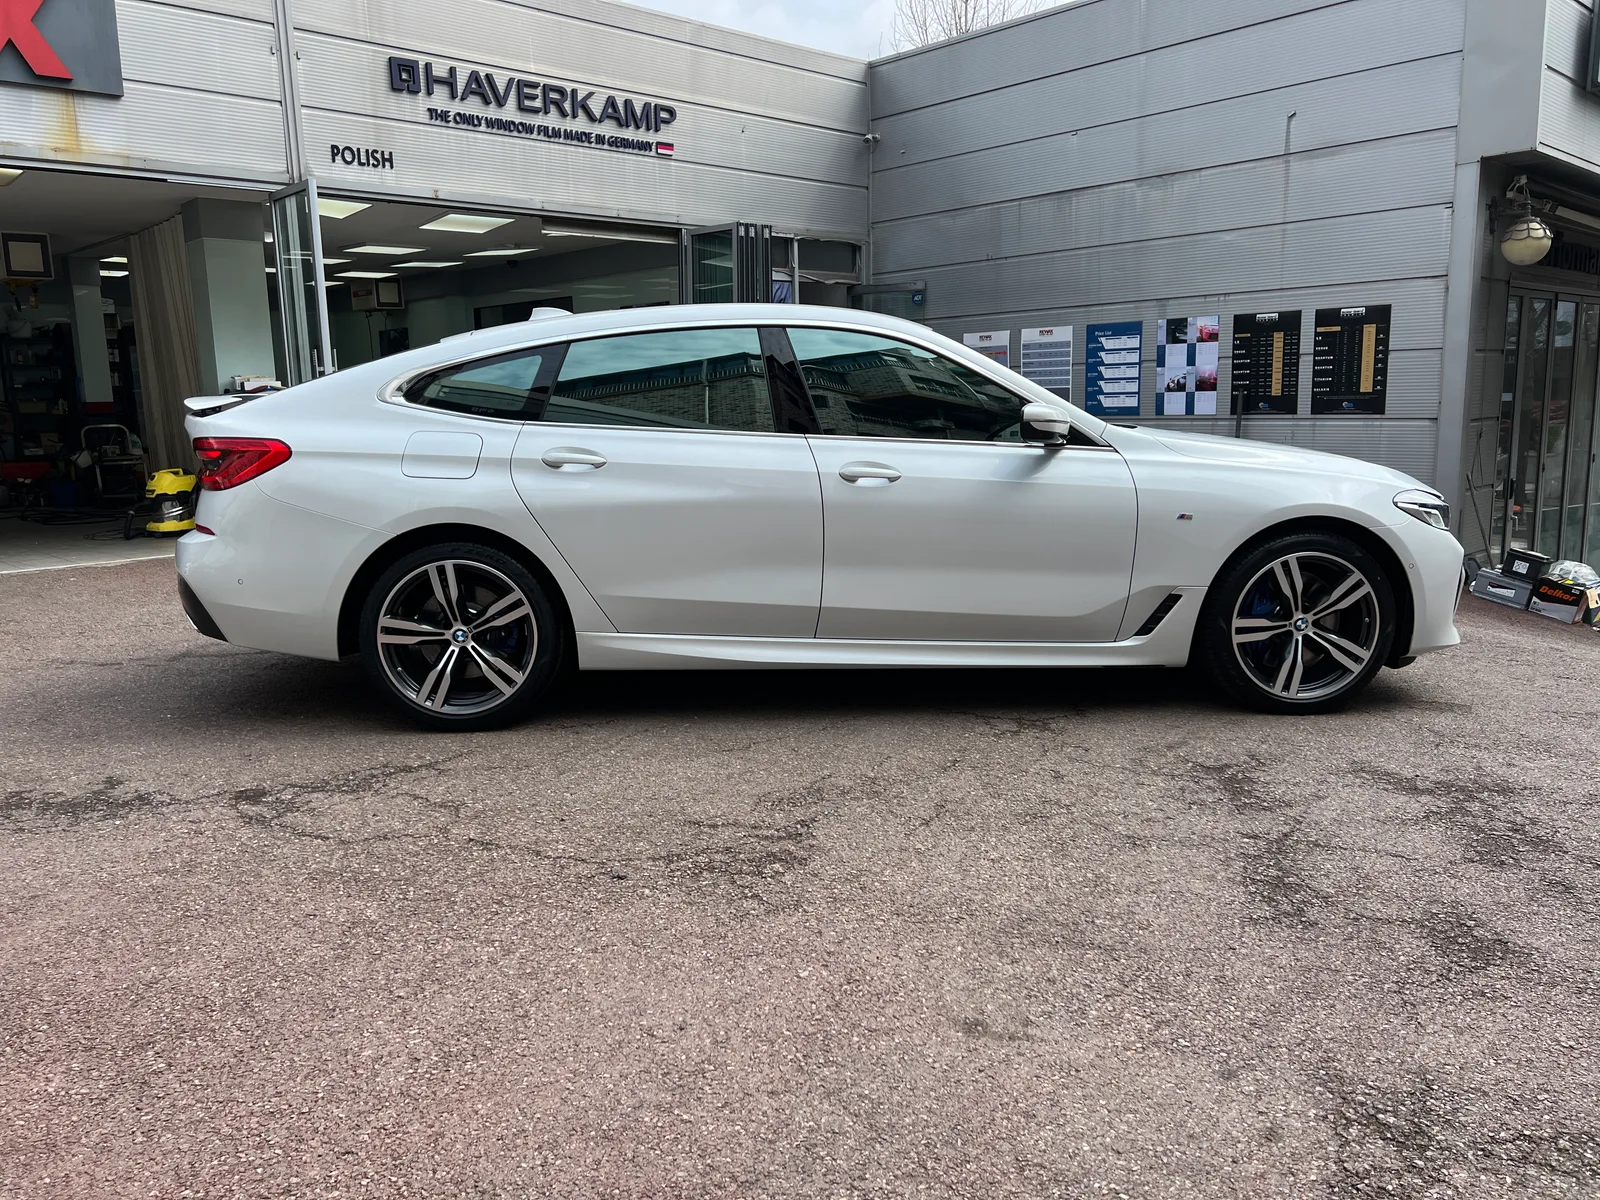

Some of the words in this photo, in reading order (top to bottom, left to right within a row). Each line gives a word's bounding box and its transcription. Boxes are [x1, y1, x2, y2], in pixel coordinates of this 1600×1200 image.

[424, 61, 677, 132] HAVERKAMP
[427, 107, 451, 123] THE
[453, 111, 484, 127] ONLY
[484, 116, 535, 135] WINDOW
[537, 124, 561, 139] FILM
[563, 128, 594, 144] MADE
[595, 133, 606, 146] IN
[607, 135, 654, 152] GERMANY
[331, 144, 394, 170] POLISH
[1540, 585, 1576, 601] Delkor
